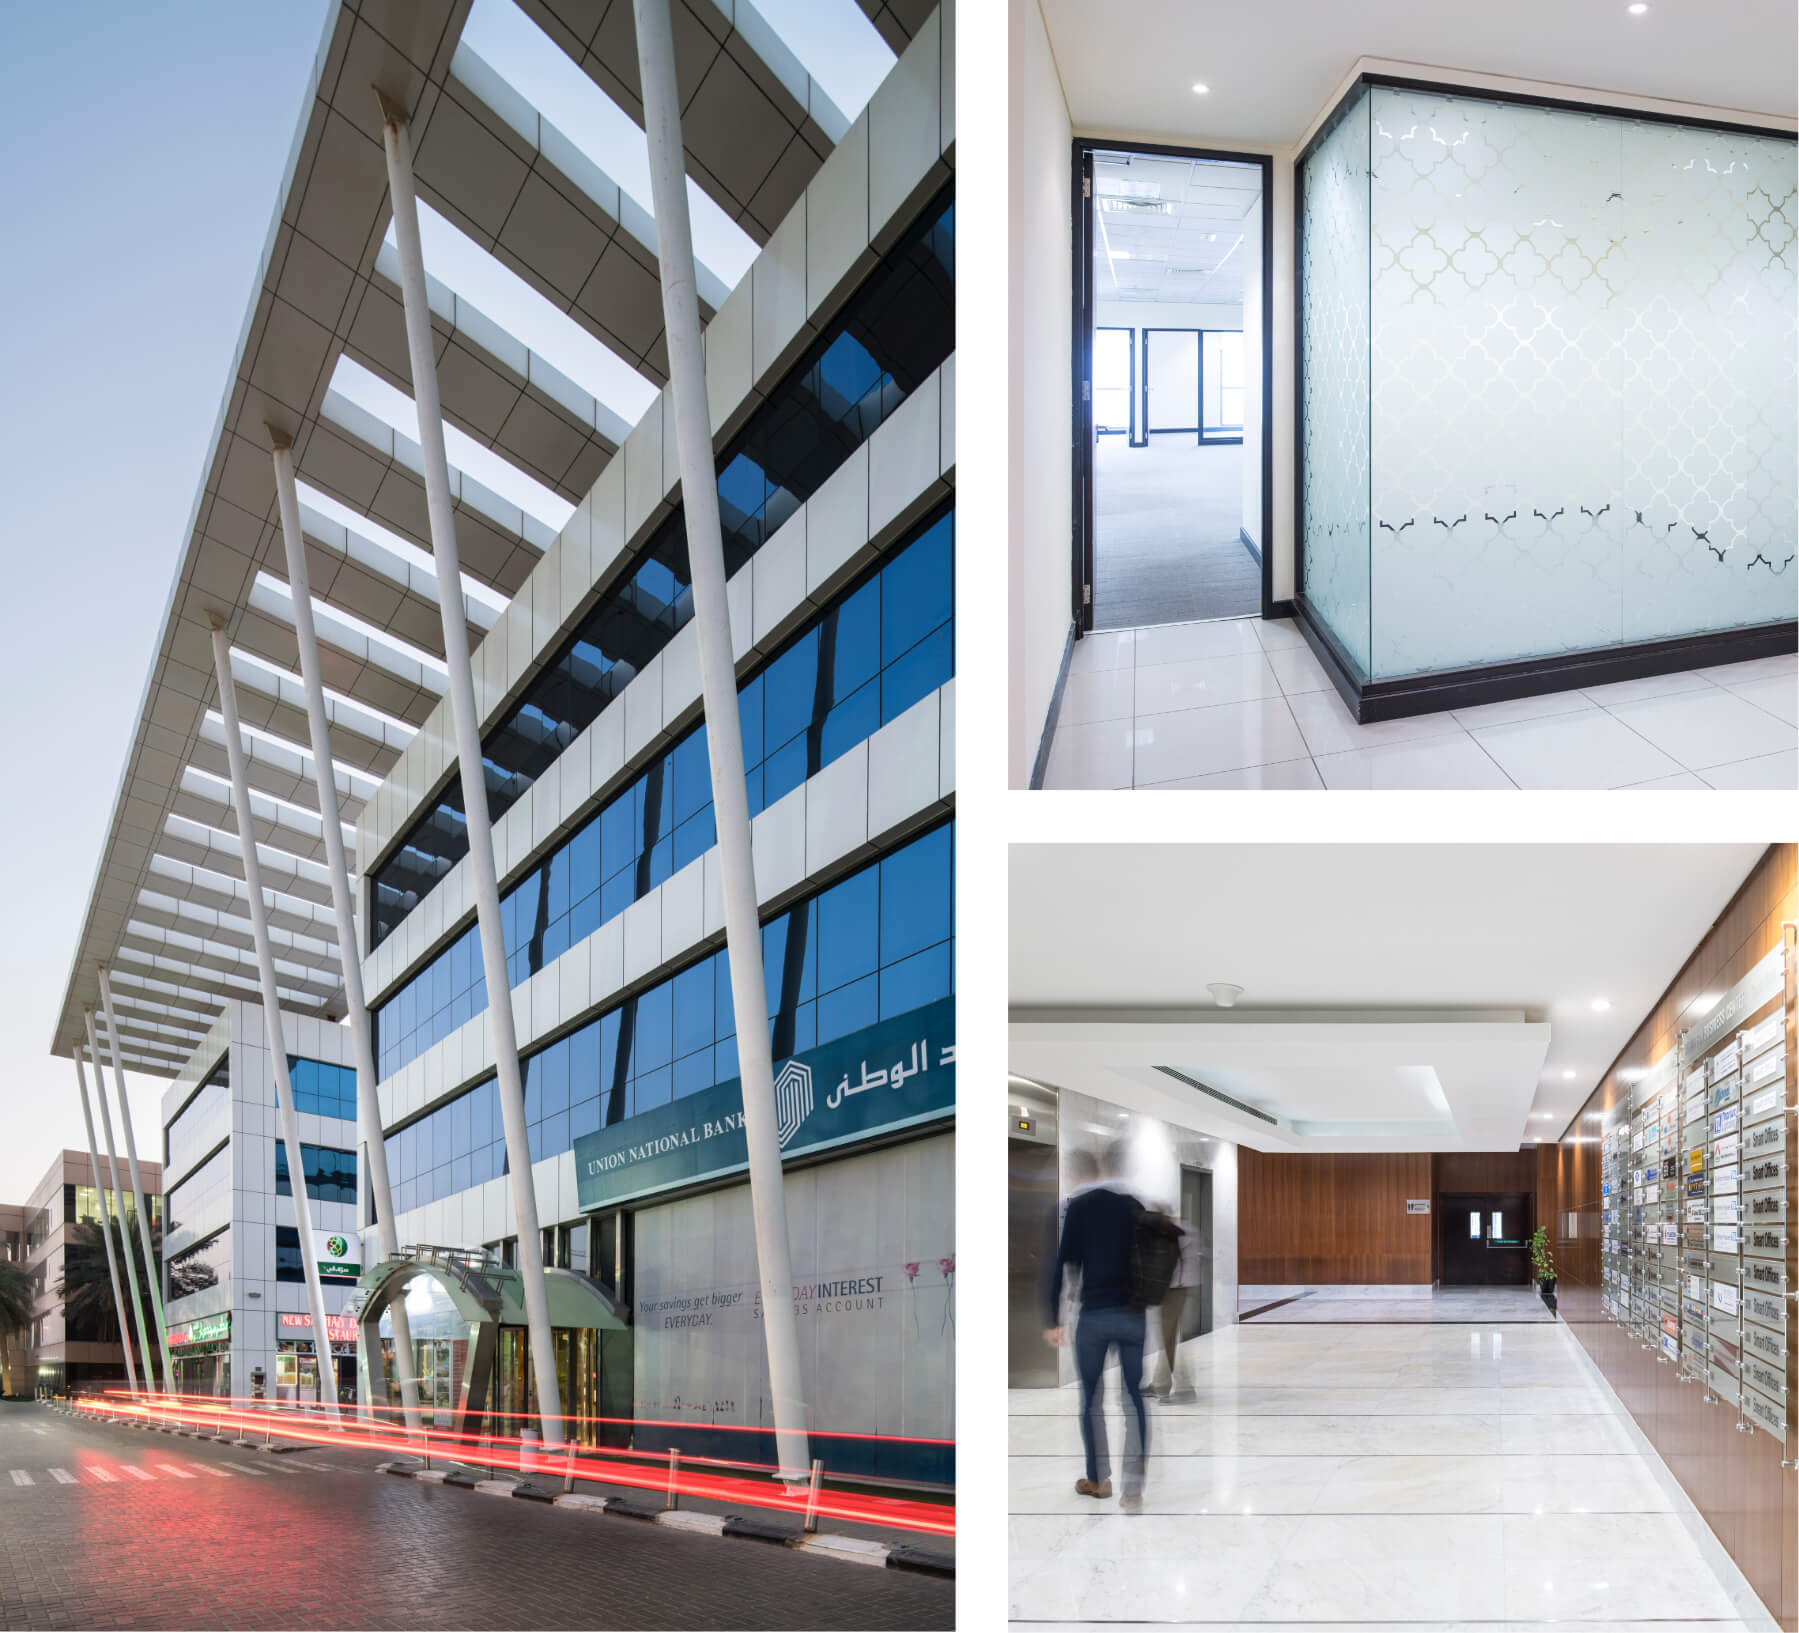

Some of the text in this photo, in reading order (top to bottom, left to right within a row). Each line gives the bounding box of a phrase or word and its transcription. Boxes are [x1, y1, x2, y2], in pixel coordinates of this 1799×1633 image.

[1753, 1127, 1779, 1148] Smart Offices
[587, 1151, 626, 1176] UNION
[629, 1127, 700, 1163] NATIONAL
[1753, 1165, 1764, 1180] Smart
[1764, 1162, 1779, 1178] Offices
[1753, 1199, 1764, 1214] Smart
[1764, 1197, 1779, 1213] Offices
[1753, 1231, 1764, 1248] Smart
[1764, 1232, 1779, 1249] Offices
[1753, 1262, 1780, 1283] Smart Offices
[817, 1276, 884, 1299] INTEREST
[639, 1290, 743, 1313] Your savings get bigger
[816, 1297, 884, 1313] ACCOUNT
[281, 1314, 303, 1327] NEW
